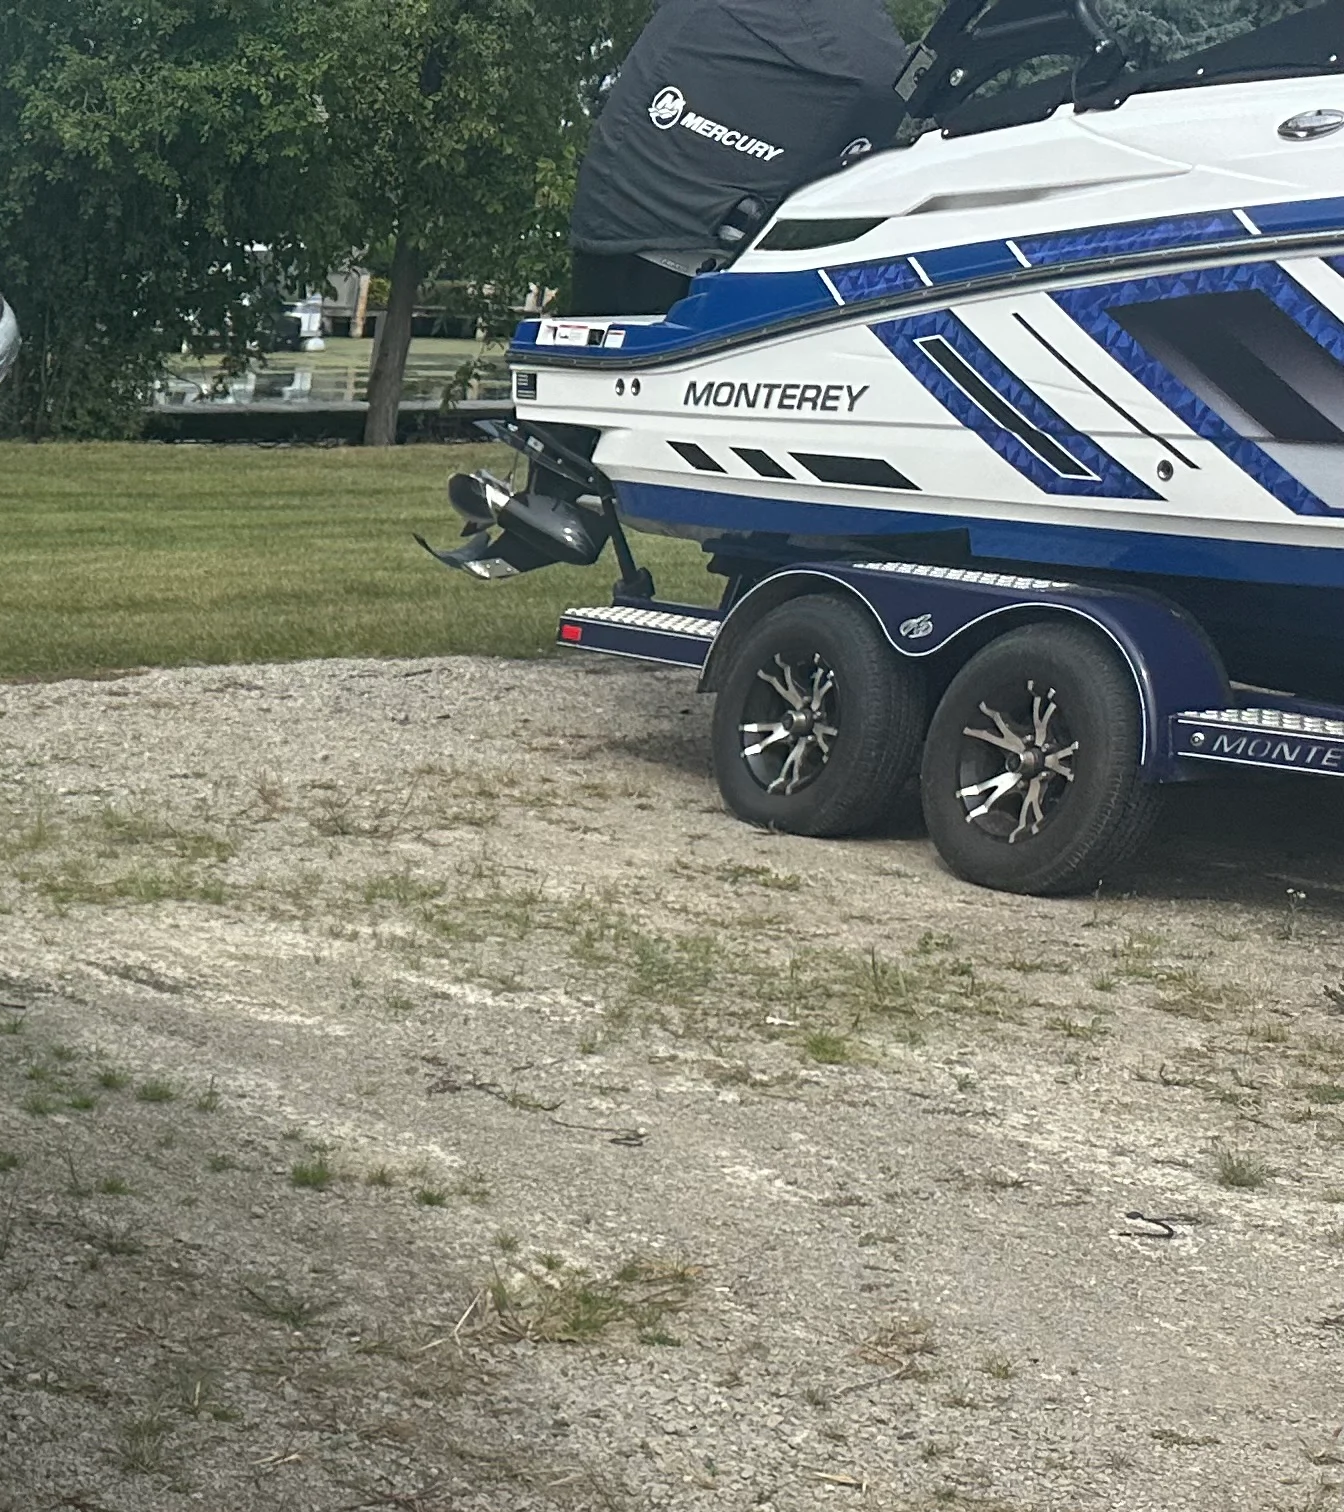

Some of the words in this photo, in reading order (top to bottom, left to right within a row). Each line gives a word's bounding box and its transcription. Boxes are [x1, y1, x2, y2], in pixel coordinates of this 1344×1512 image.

[679, 111, 785, 162] MERCURY
[683, 380, 870, 412] MONTEREY
[1212, 734, 1344, 767] MONTE
